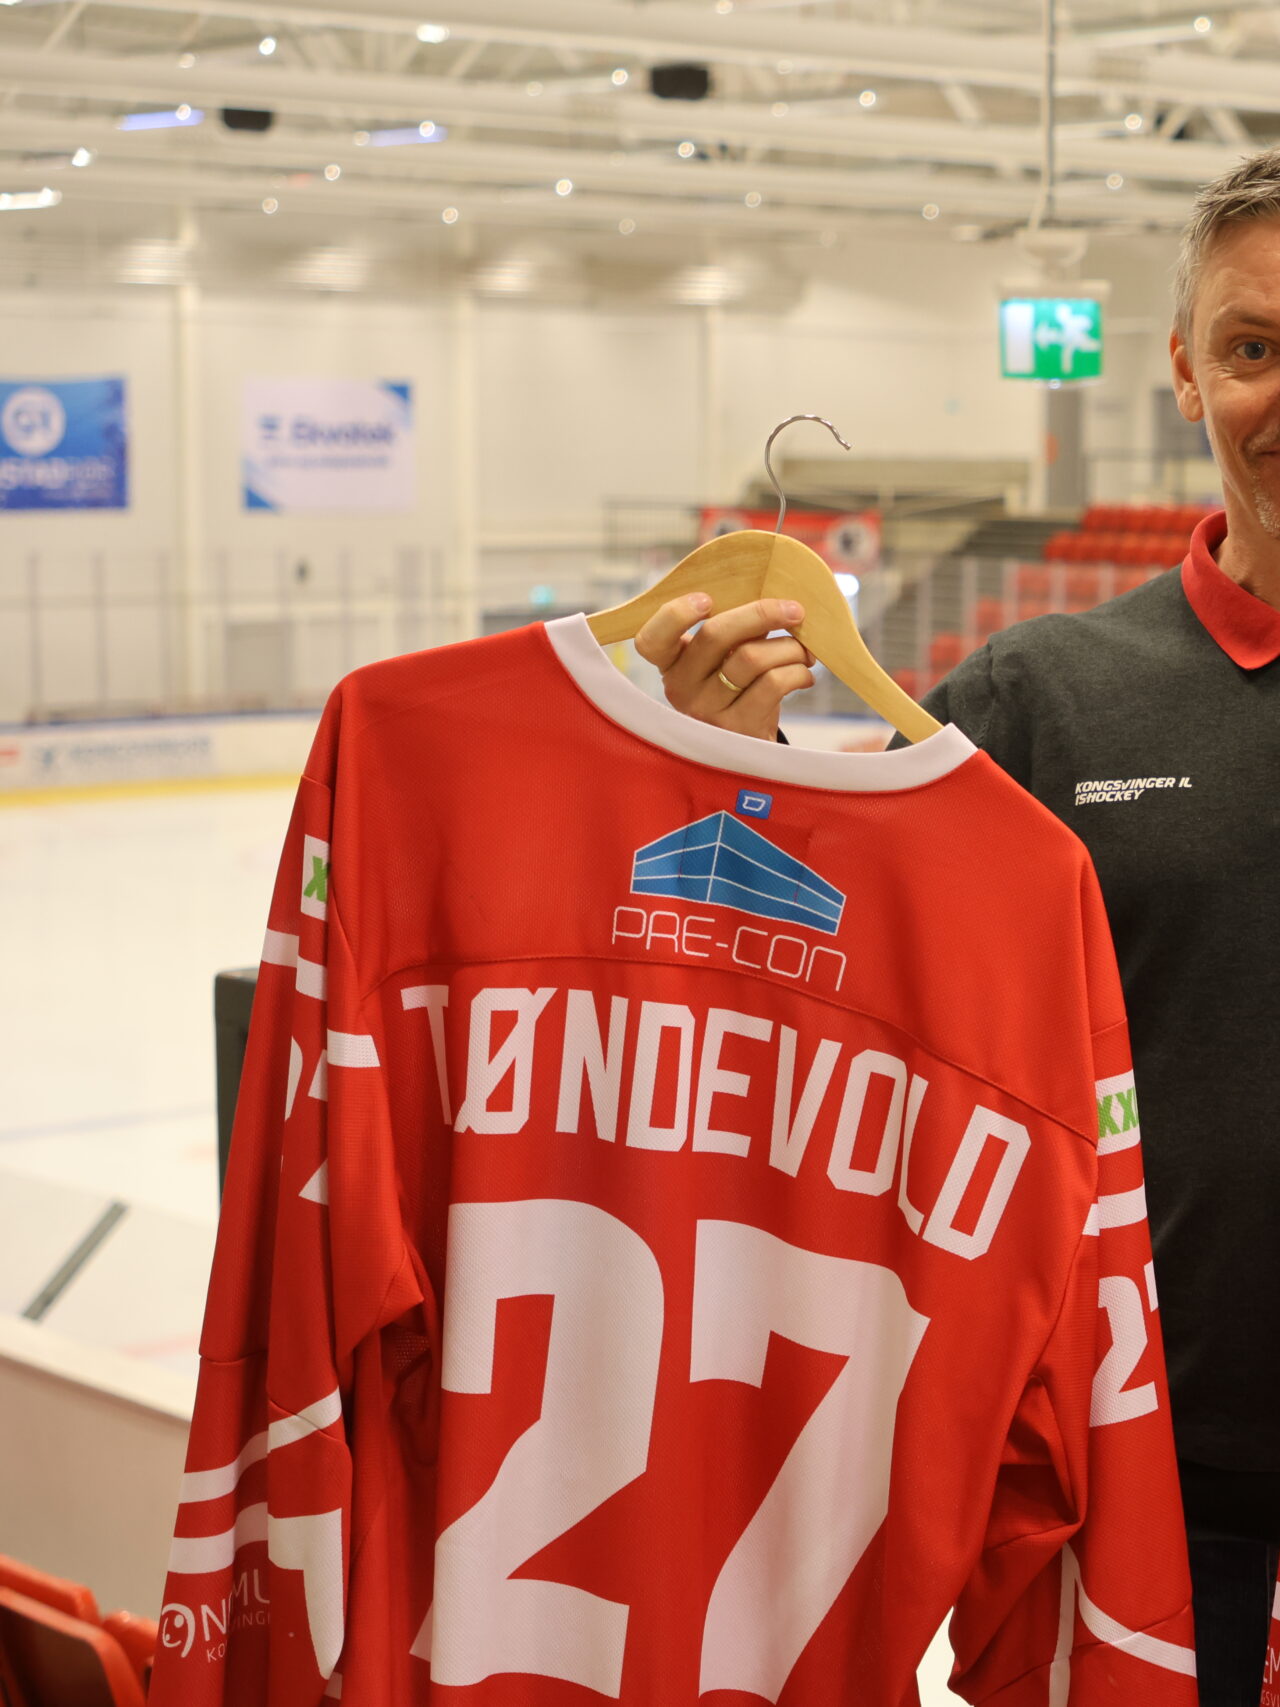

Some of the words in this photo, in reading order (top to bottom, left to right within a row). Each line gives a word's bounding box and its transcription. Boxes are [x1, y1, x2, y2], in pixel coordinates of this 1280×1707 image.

[1075, 777, 1176, 794] KONGSVINGER
[1178, 777, 1193, 788] IL
[1075, 789, 1145, 806] ISHOCKEY
[612, 906, 847, 991] PRE-CON
[400, 984, 1032, 1261] TØNDEVOLD
[1097, 1087, 1139, 1138] XX
[409, 1198, 931, 1705] 27
